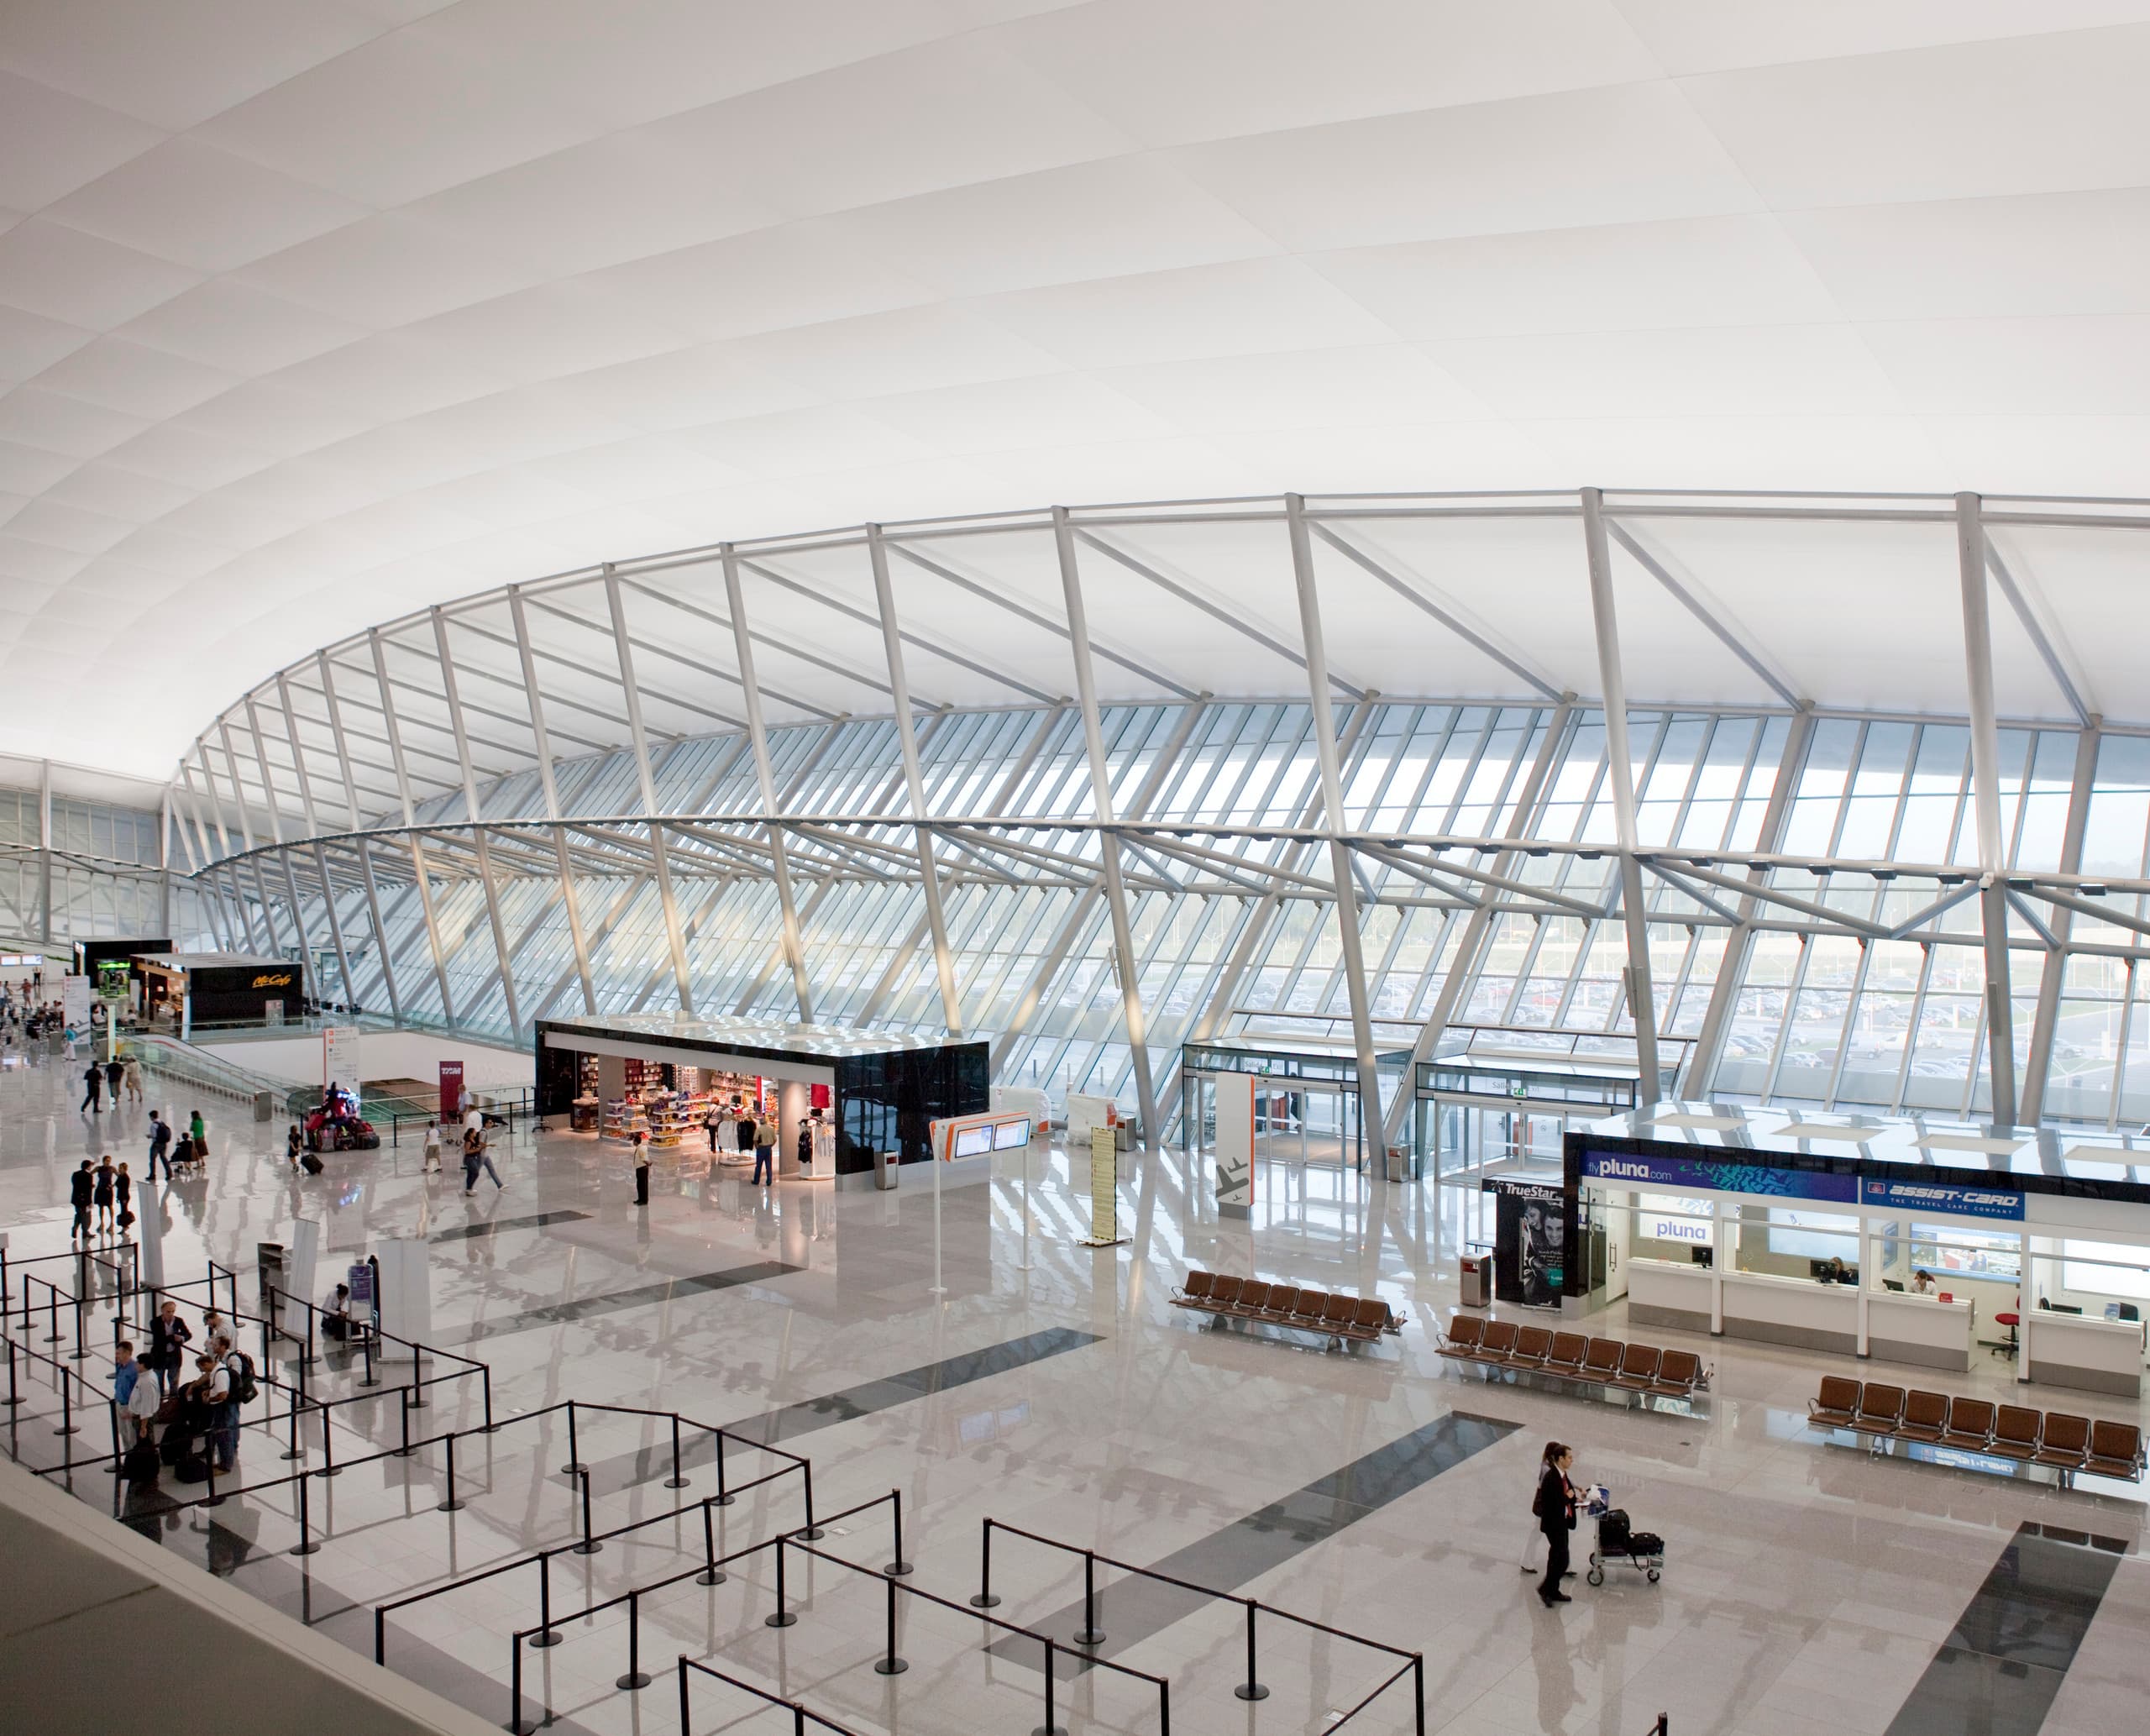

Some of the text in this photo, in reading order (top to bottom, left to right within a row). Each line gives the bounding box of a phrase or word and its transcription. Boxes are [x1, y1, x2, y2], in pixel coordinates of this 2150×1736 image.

[1506, 1183, 1558, 1198] TrueStar
[1974, 1206, 2013, 1214] COMPANY
[1657, 1221, 1706, 1240] pluna
